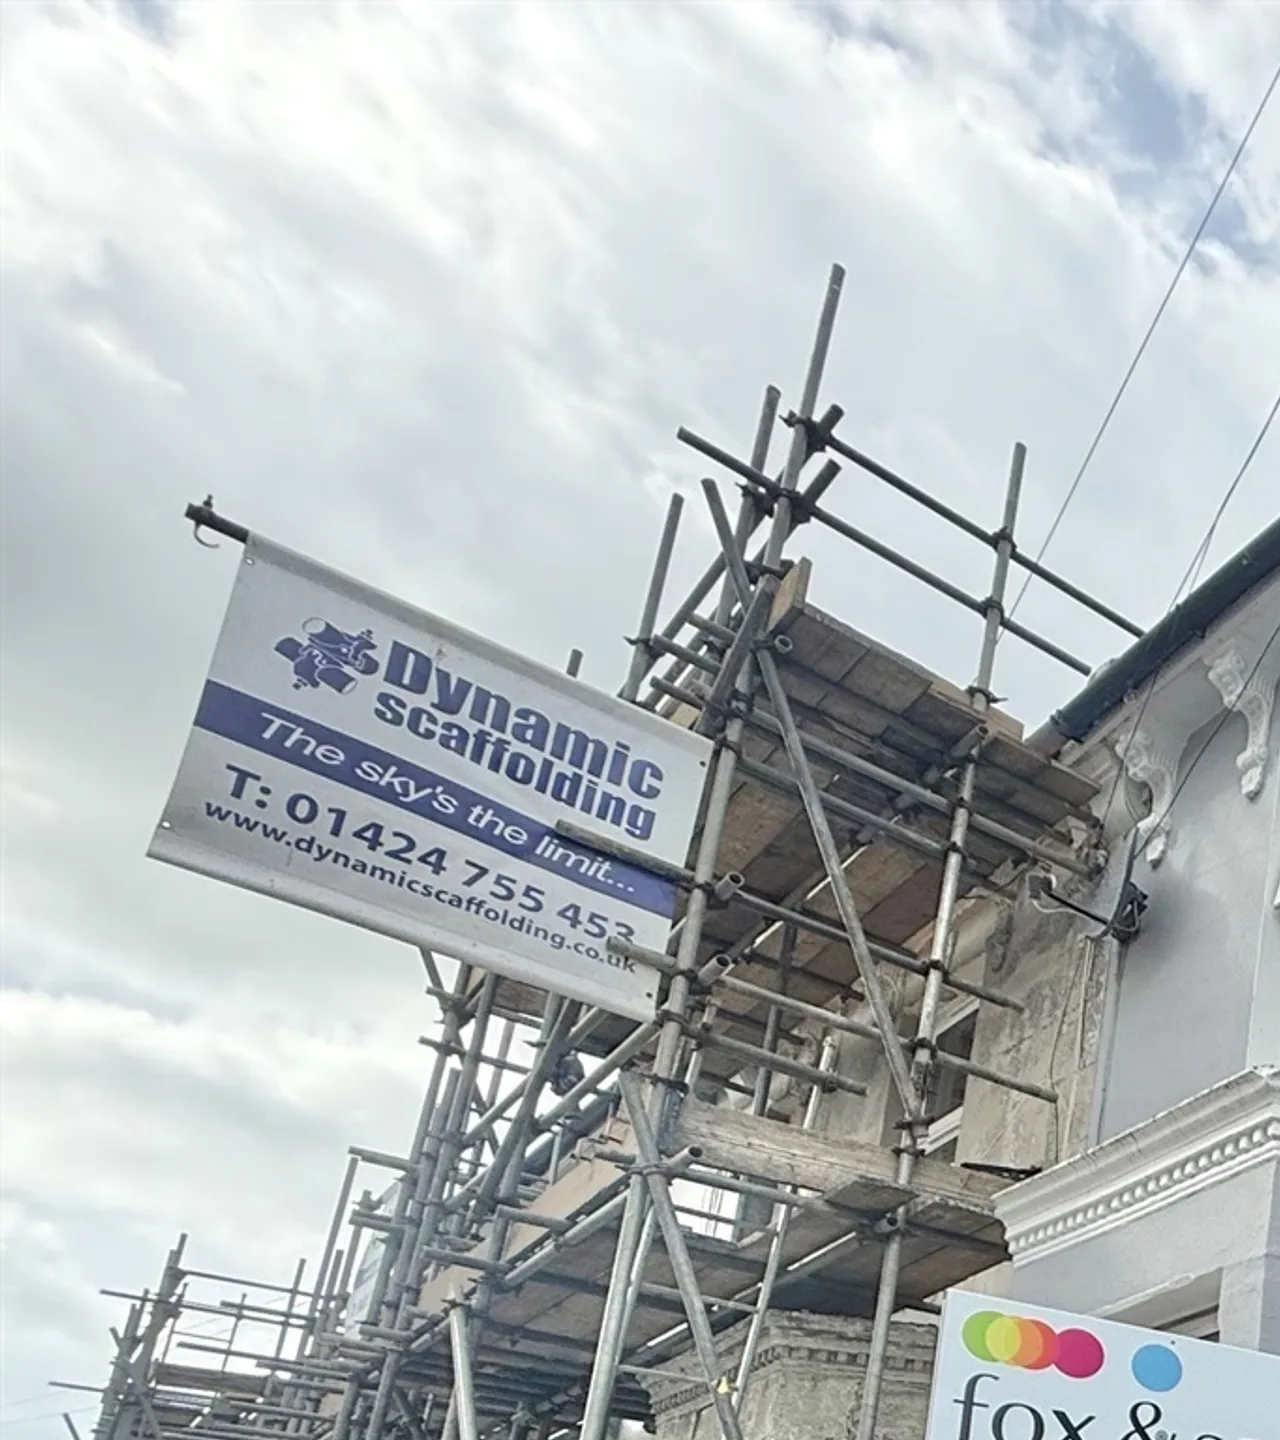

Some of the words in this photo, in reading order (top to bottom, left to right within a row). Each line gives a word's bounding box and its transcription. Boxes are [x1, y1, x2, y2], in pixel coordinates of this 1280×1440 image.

[258, 712, 345, 767] The
[355, 759, 461, 815] sky's
[467, 797, 529, 845] the
[535, 833, 635, 893] limit...
[373, 692, 657, 841] scaffolding
[383, 640, 665, 799] Dynamic
[204, 800, 637, 973] www.dynamicscaffolding.co.uk
[225, 763, 272, 810] T:
[286, 790, 447, 875] 01424
[462, 857, 545, 914] 755
[555, 901, 636, 946] 453
